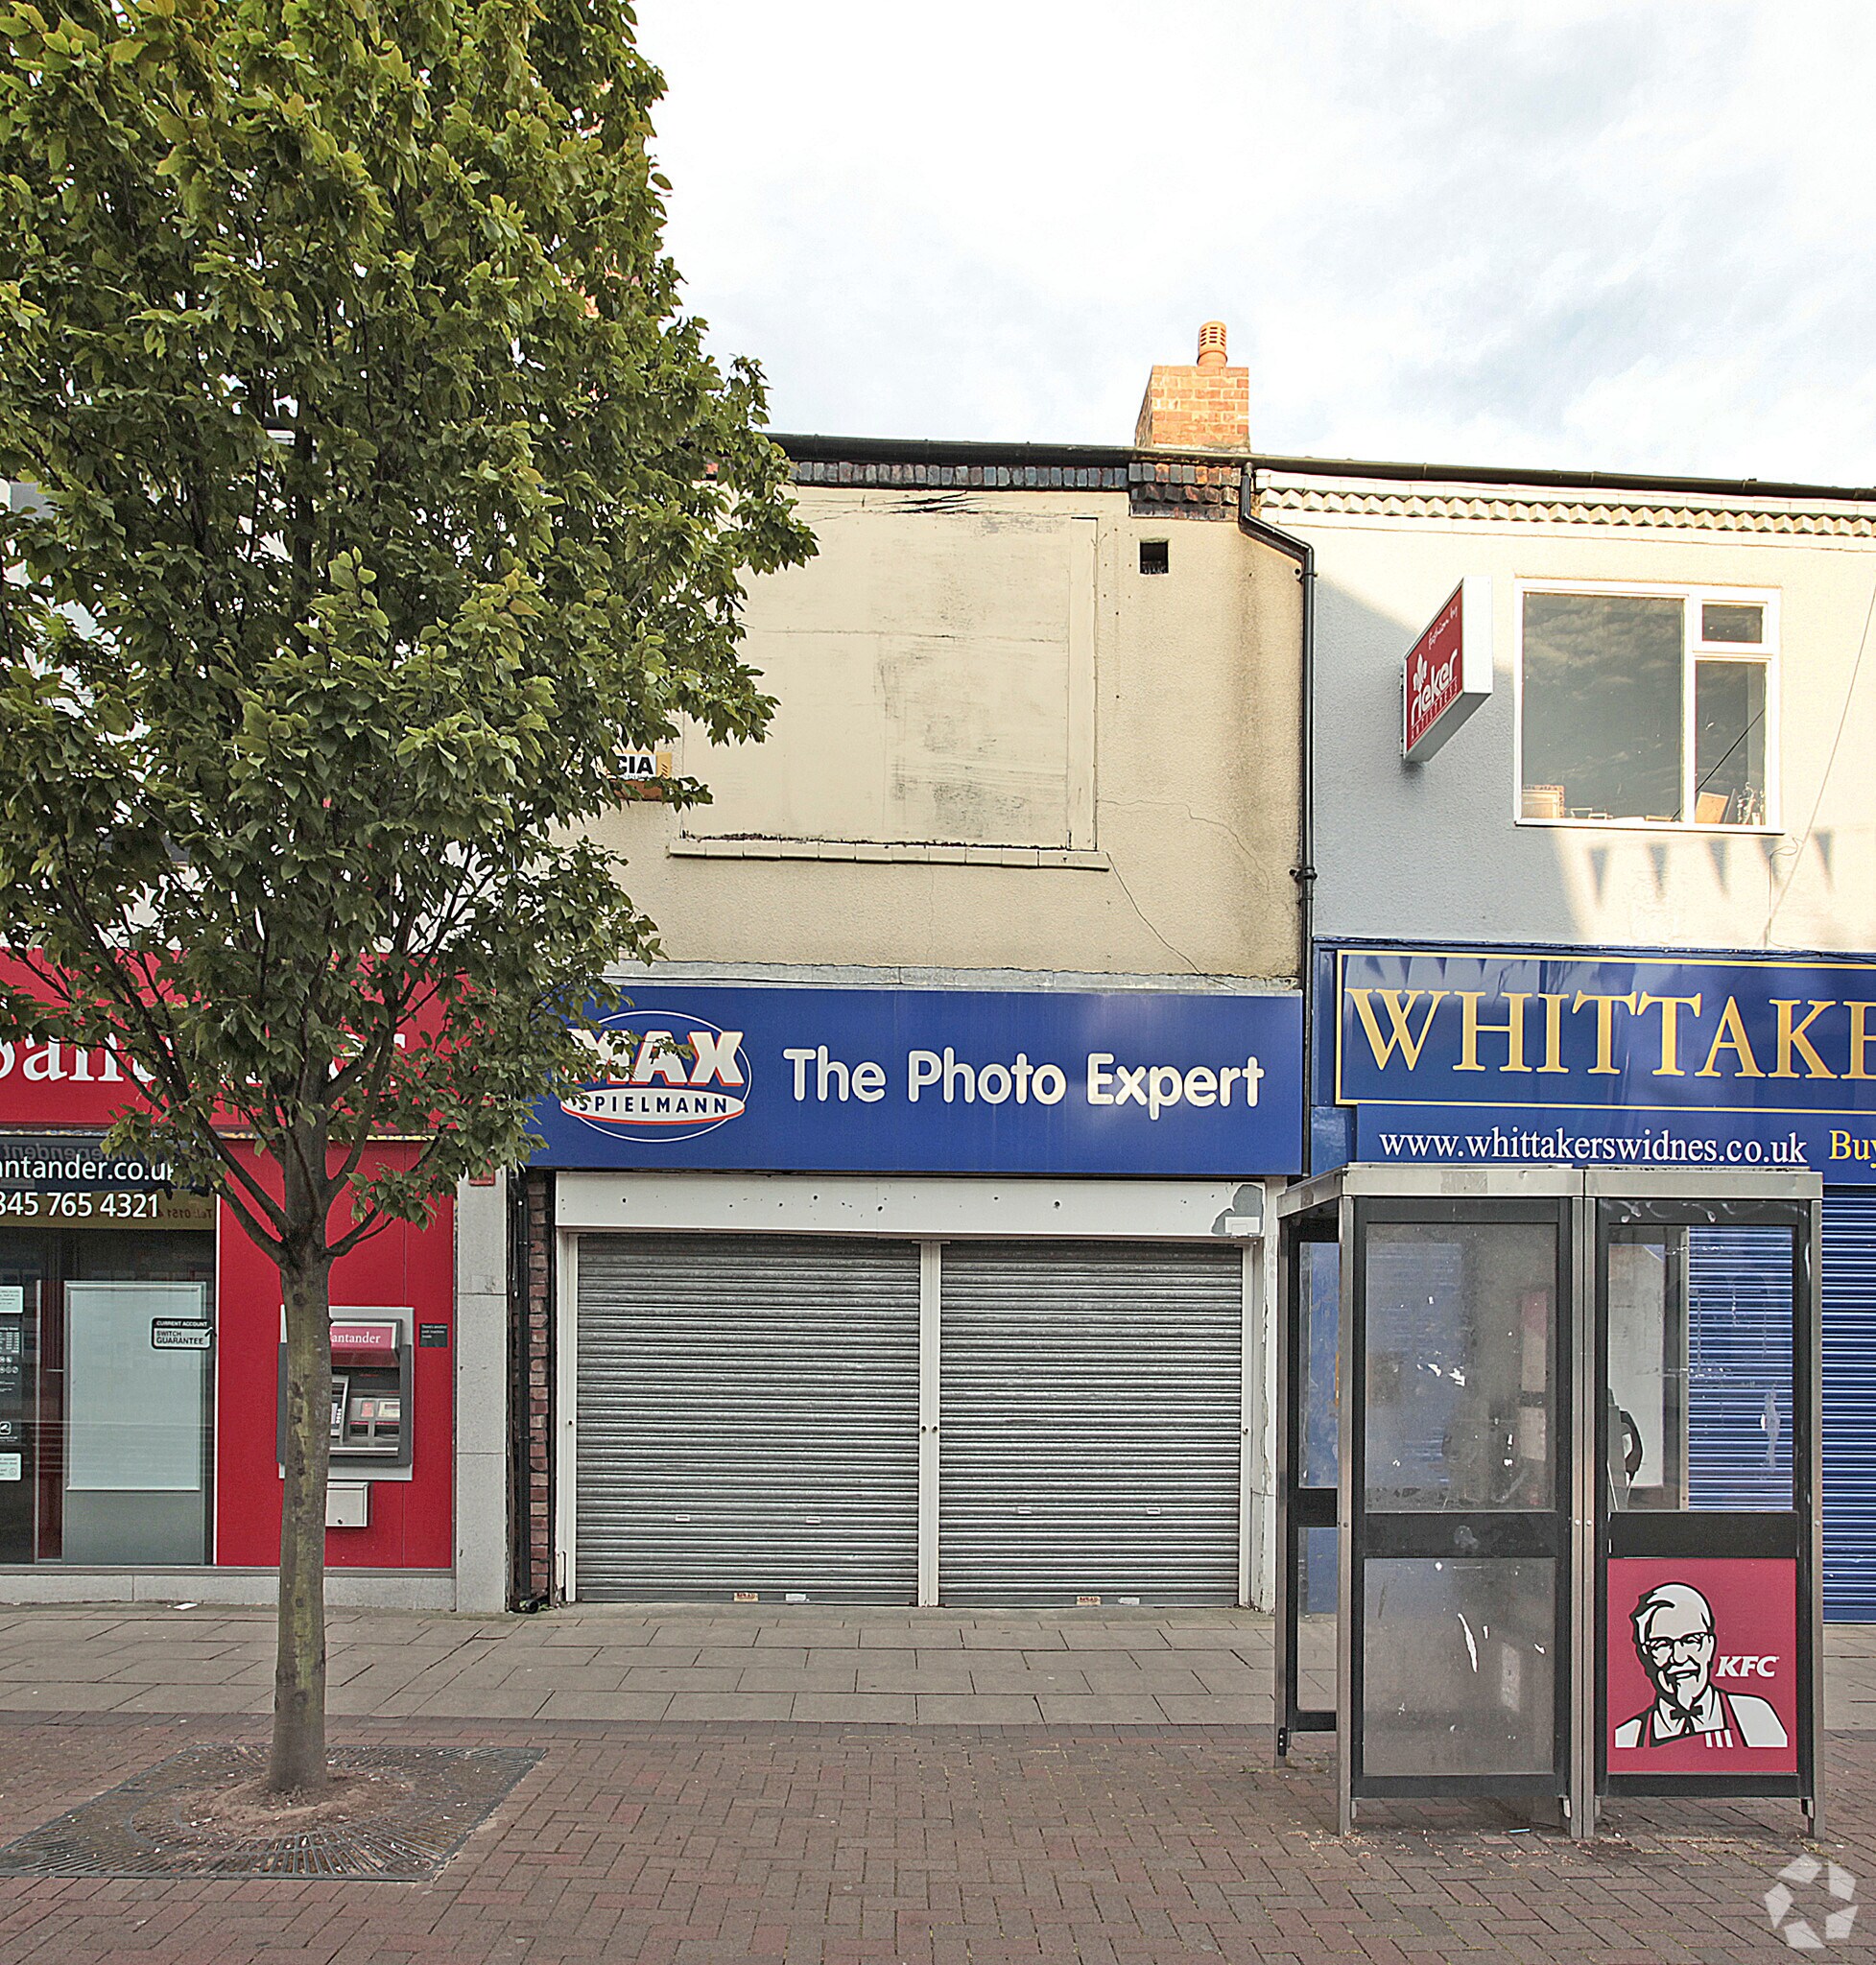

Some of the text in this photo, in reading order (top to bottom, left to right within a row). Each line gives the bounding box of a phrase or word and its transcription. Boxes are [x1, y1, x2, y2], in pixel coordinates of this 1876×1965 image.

[1411, 648, 1459, 726] rieker
[1411, 679, 1459, 741] ANTISTRESS
[1343, 988, 1876, 1080] WHITTAKE
[783, 1045, 1265, 1121] The Photo Expert
[578, 1096, 728, 1114] SPIELMANN
[1379, 1126, 1808, 1165] www.whittakerswidnes.co.uk
[47, 1192, 93, 1218] 765
[100, 1193, 159, 1219] 4321
[156, 1337, 204, 1345] GUARANTEE
[330, 1332, 382, 1343] antander
[1715, 1655, 1777, 1678] KFC
